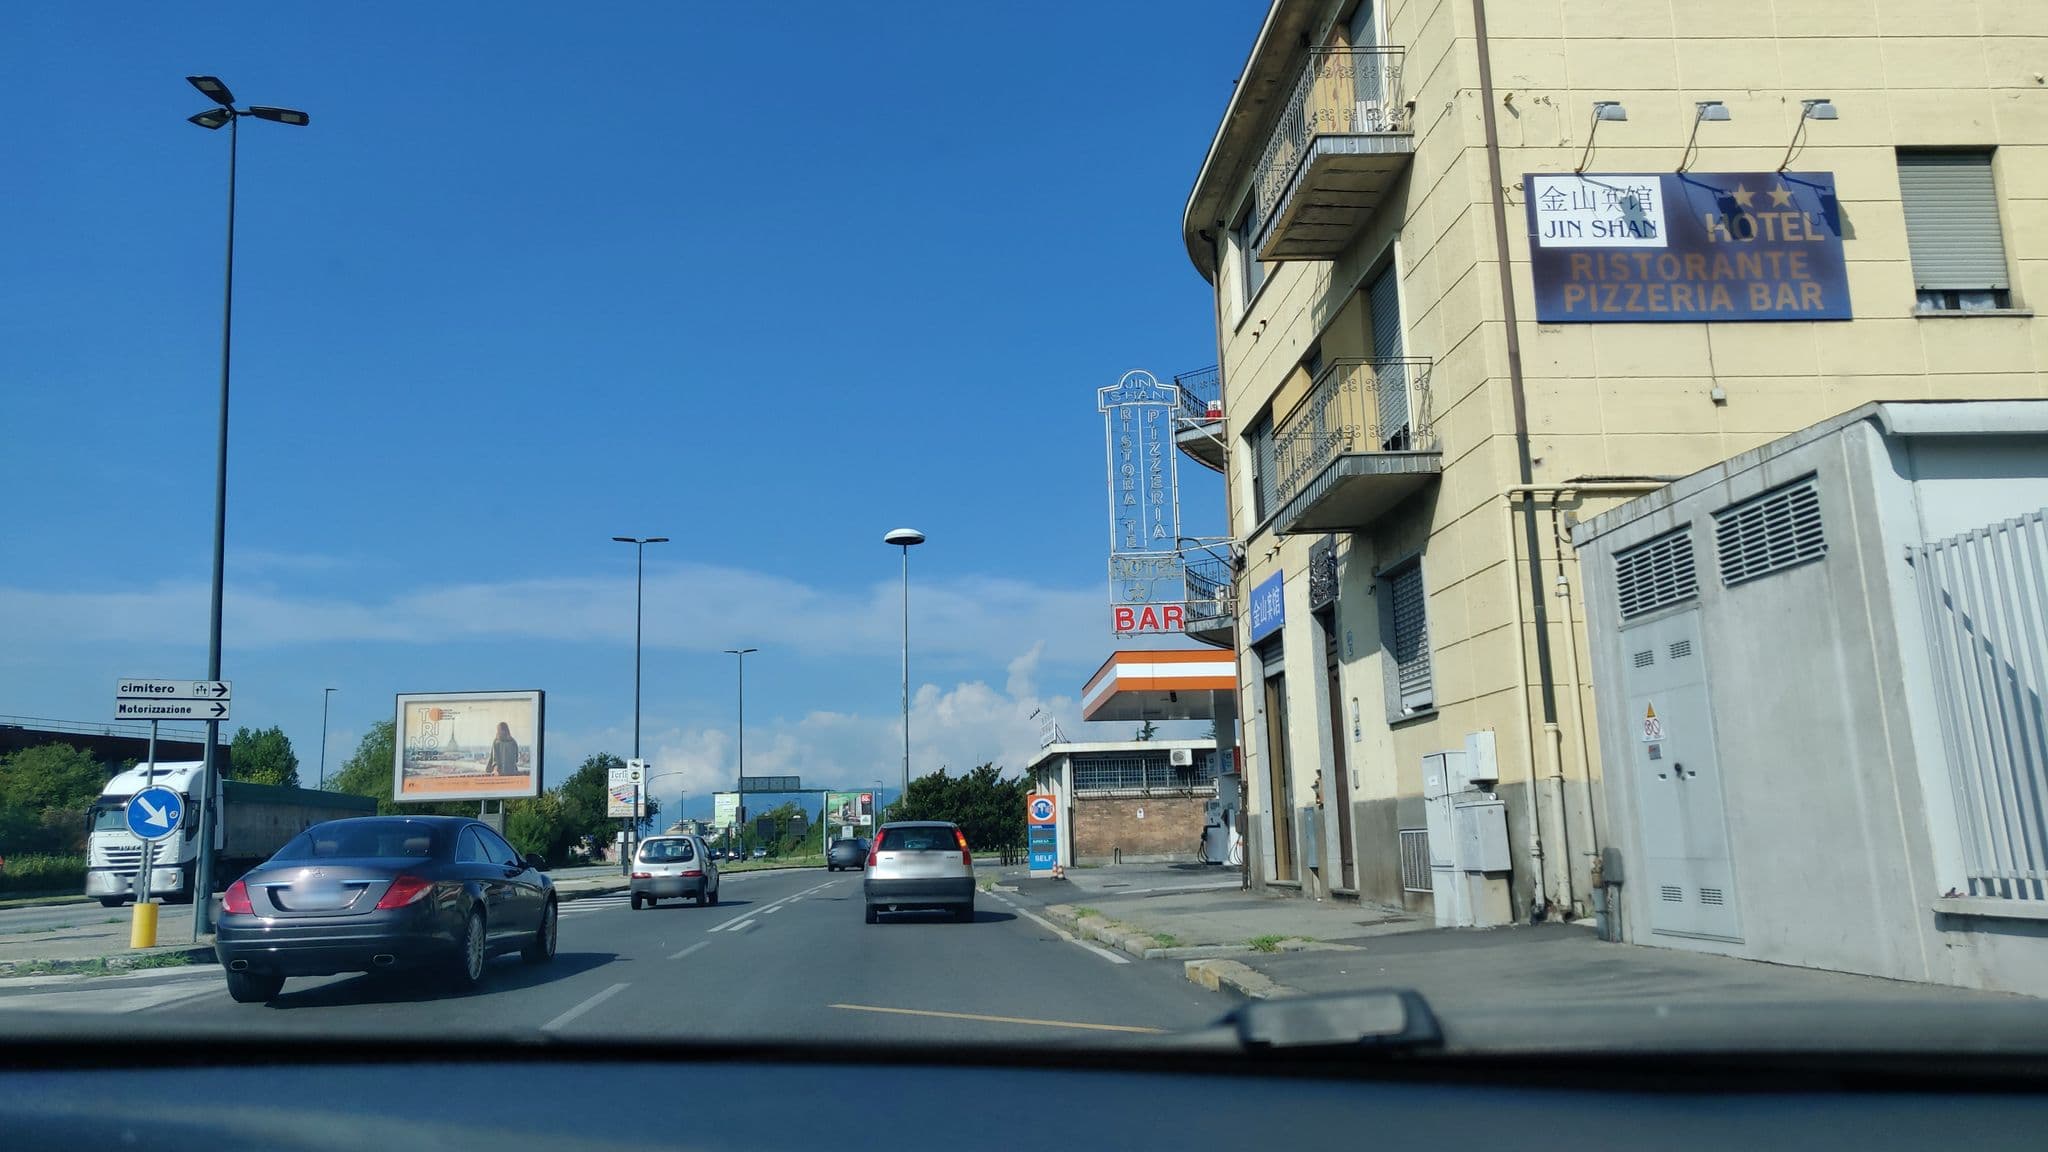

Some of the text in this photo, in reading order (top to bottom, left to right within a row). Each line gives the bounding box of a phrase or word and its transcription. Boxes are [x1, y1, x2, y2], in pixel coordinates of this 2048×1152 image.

[1539, 185, 1653, 213] 金山宾馆
[1544, 219, 1658, 239] JIN SHAN
[1705, 212, 1825, 243] HOTEL
[1570, 250, 1811, 281] RISTORANTE
[1563, 281, 1825, 313] PIZZERIA BAR
[1125, 378, 1151, 389] JIN
[1109, 389, 1165, 402] SHAN
[1147, 409, 1167, 538] PIZZERIA
[1110, 558, 1184, 579] HOTEL
[1114, 604, 1185, 633] BAR
[120, 682, 175, 694] cimitero
[118, 703, 192, 714] Motorizzazione
[1034, 854, 1054, 863] SELF
